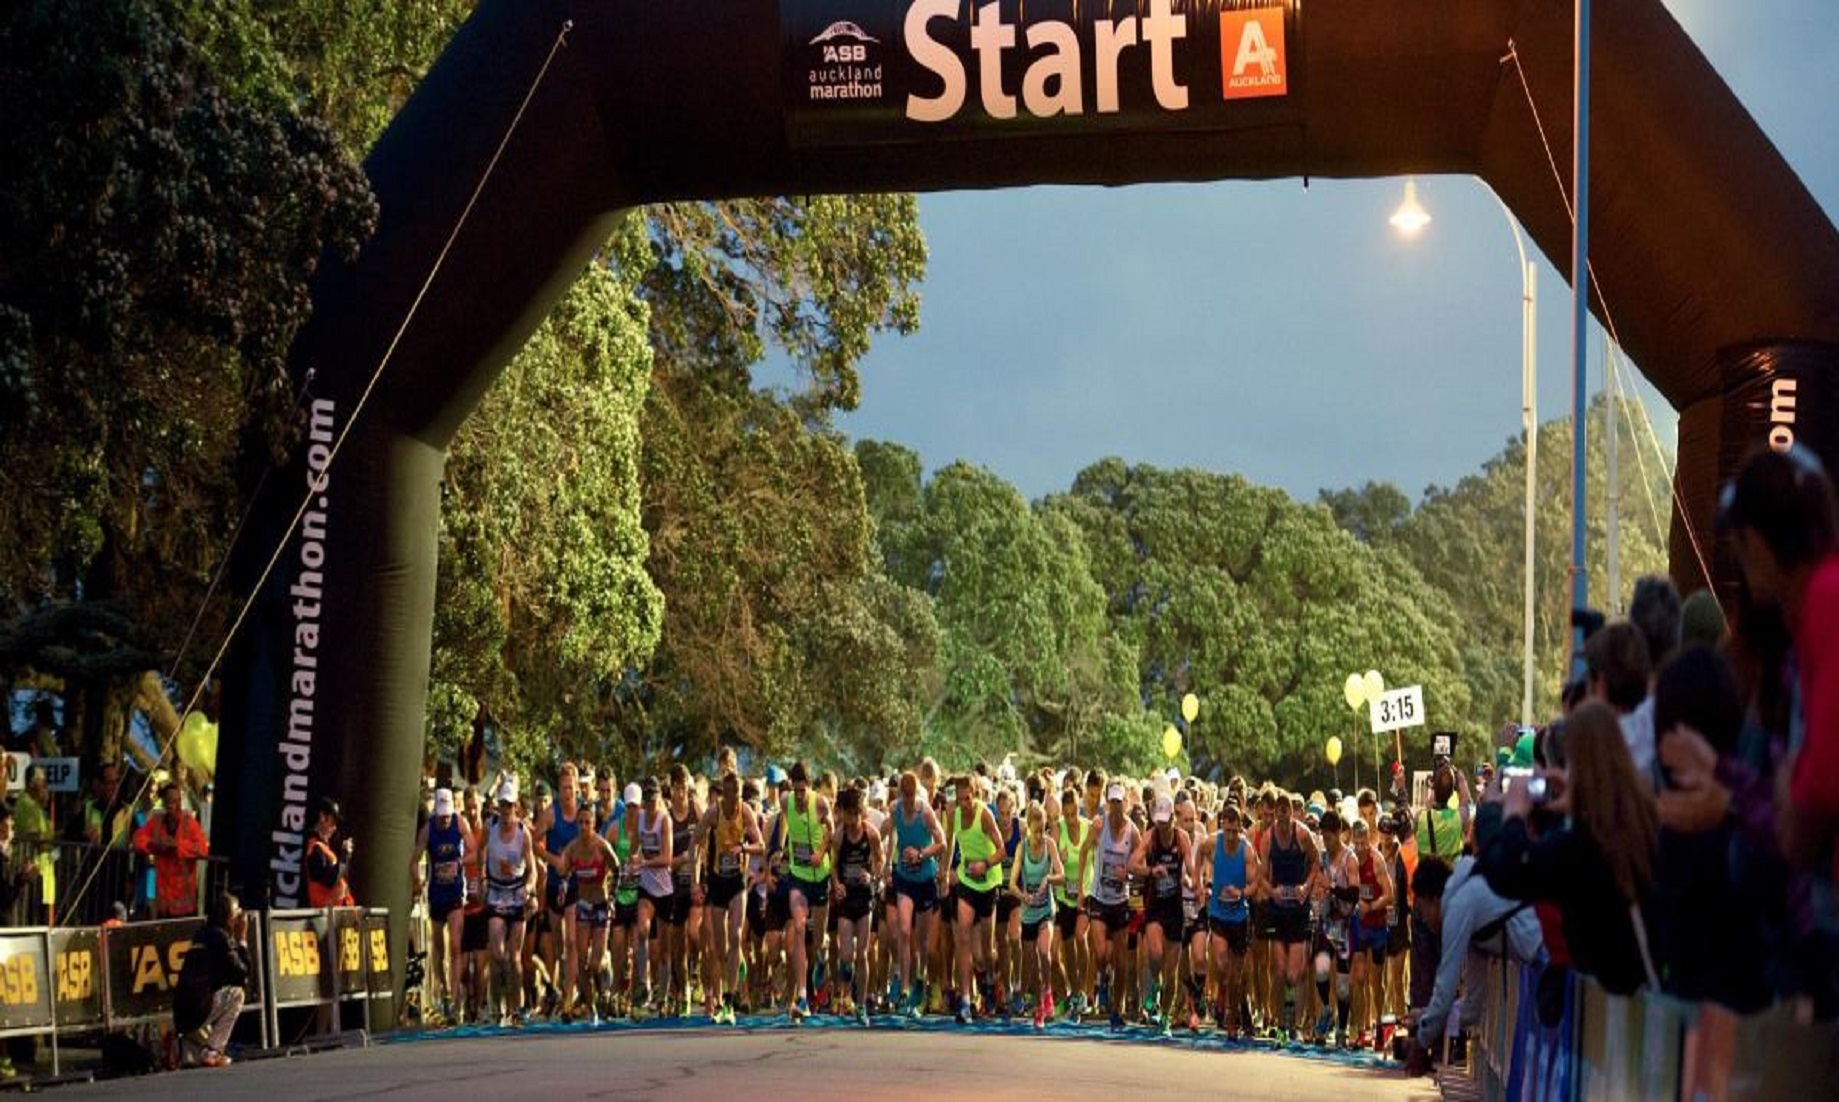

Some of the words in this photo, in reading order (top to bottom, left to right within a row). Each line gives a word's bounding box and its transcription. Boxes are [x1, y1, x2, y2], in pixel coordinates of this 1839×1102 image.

[904, 0, 1189, 122] Start
[809, 64, 882, 82] auckland
[1228, 74, 1281, 89] AUCKLAND
[810, 81, 882, 99] marathon
[1381, 694, 1414, 724] 3:15
